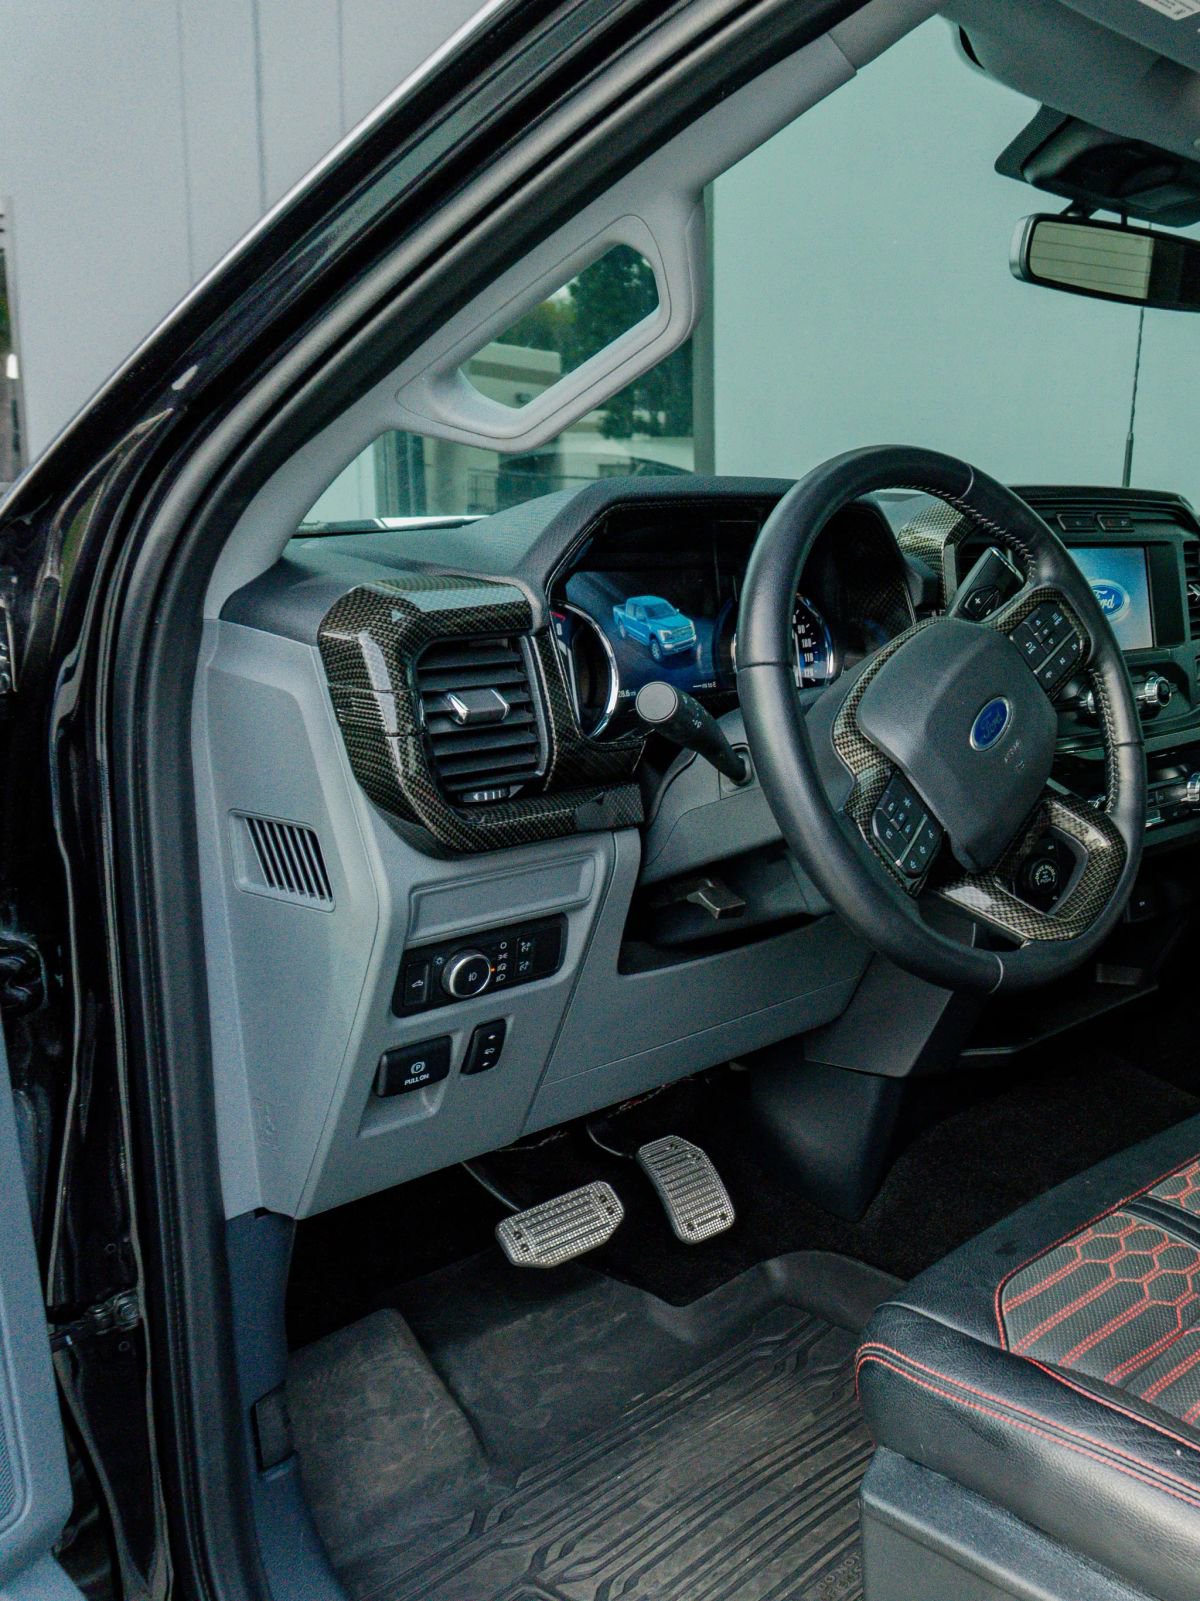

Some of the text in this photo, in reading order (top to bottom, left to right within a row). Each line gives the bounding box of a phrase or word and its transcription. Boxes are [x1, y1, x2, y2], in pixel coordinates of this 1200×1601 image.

[1093, 589, 1115, 609] Frd
[404, 1073, 430, 1086] PULL ON
